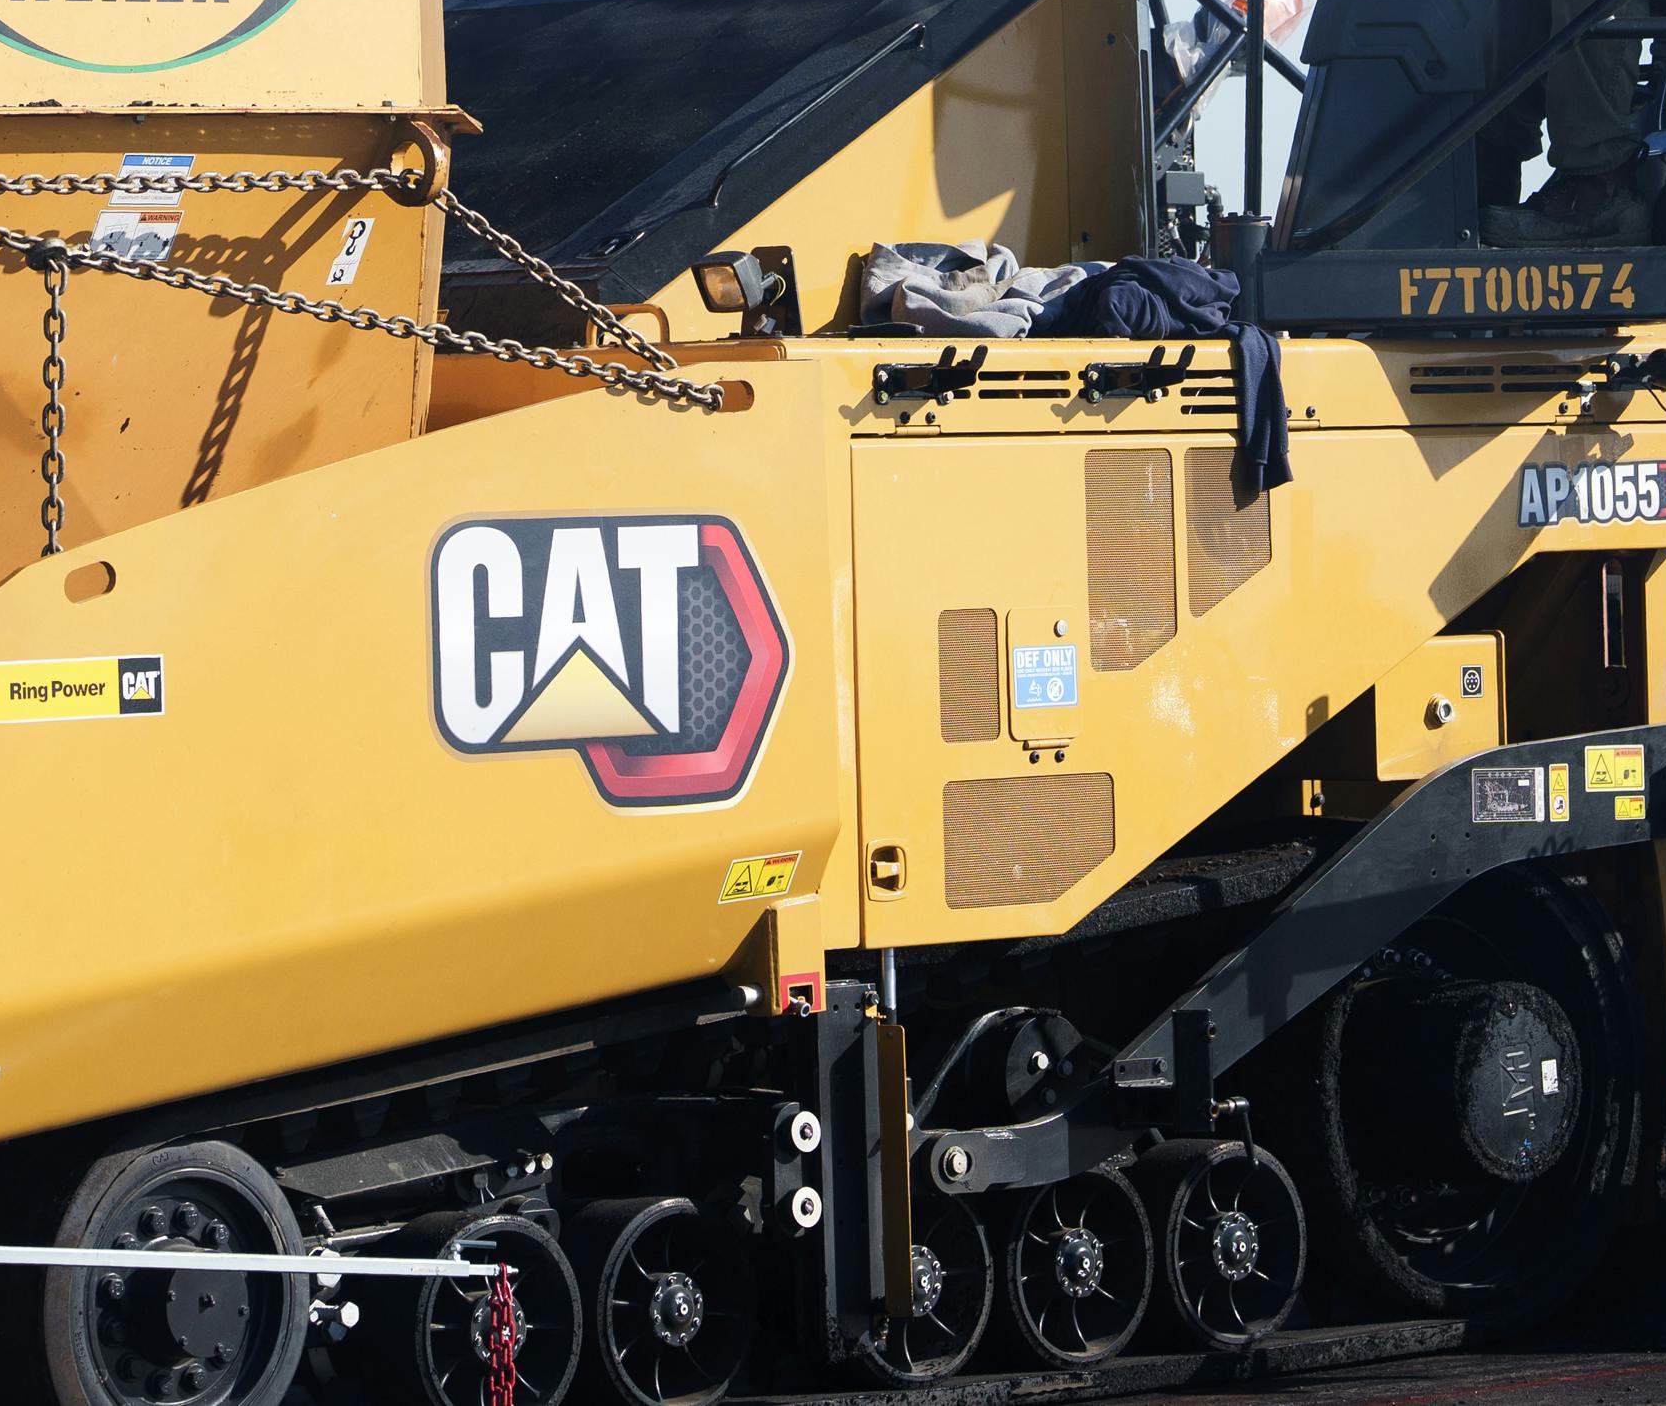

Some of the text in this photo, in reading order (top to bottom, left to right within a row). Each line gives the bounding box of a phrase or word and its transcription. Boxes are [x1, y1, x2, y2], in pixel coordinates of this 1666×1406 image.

[141, 156, 173, 166] NOTICE
[146, 214, 180, 223] WARNING
[1399, 262, 1635, 315] F7T00574
[1520, 462, 1661, 524] AP1055
[437, 524, 699, 745] CAT
[1016, 649, 1073, 669] DEF ONLY
[9, 680, 106, 703] Ring Power
[121, 670, 158, 701] CAT
